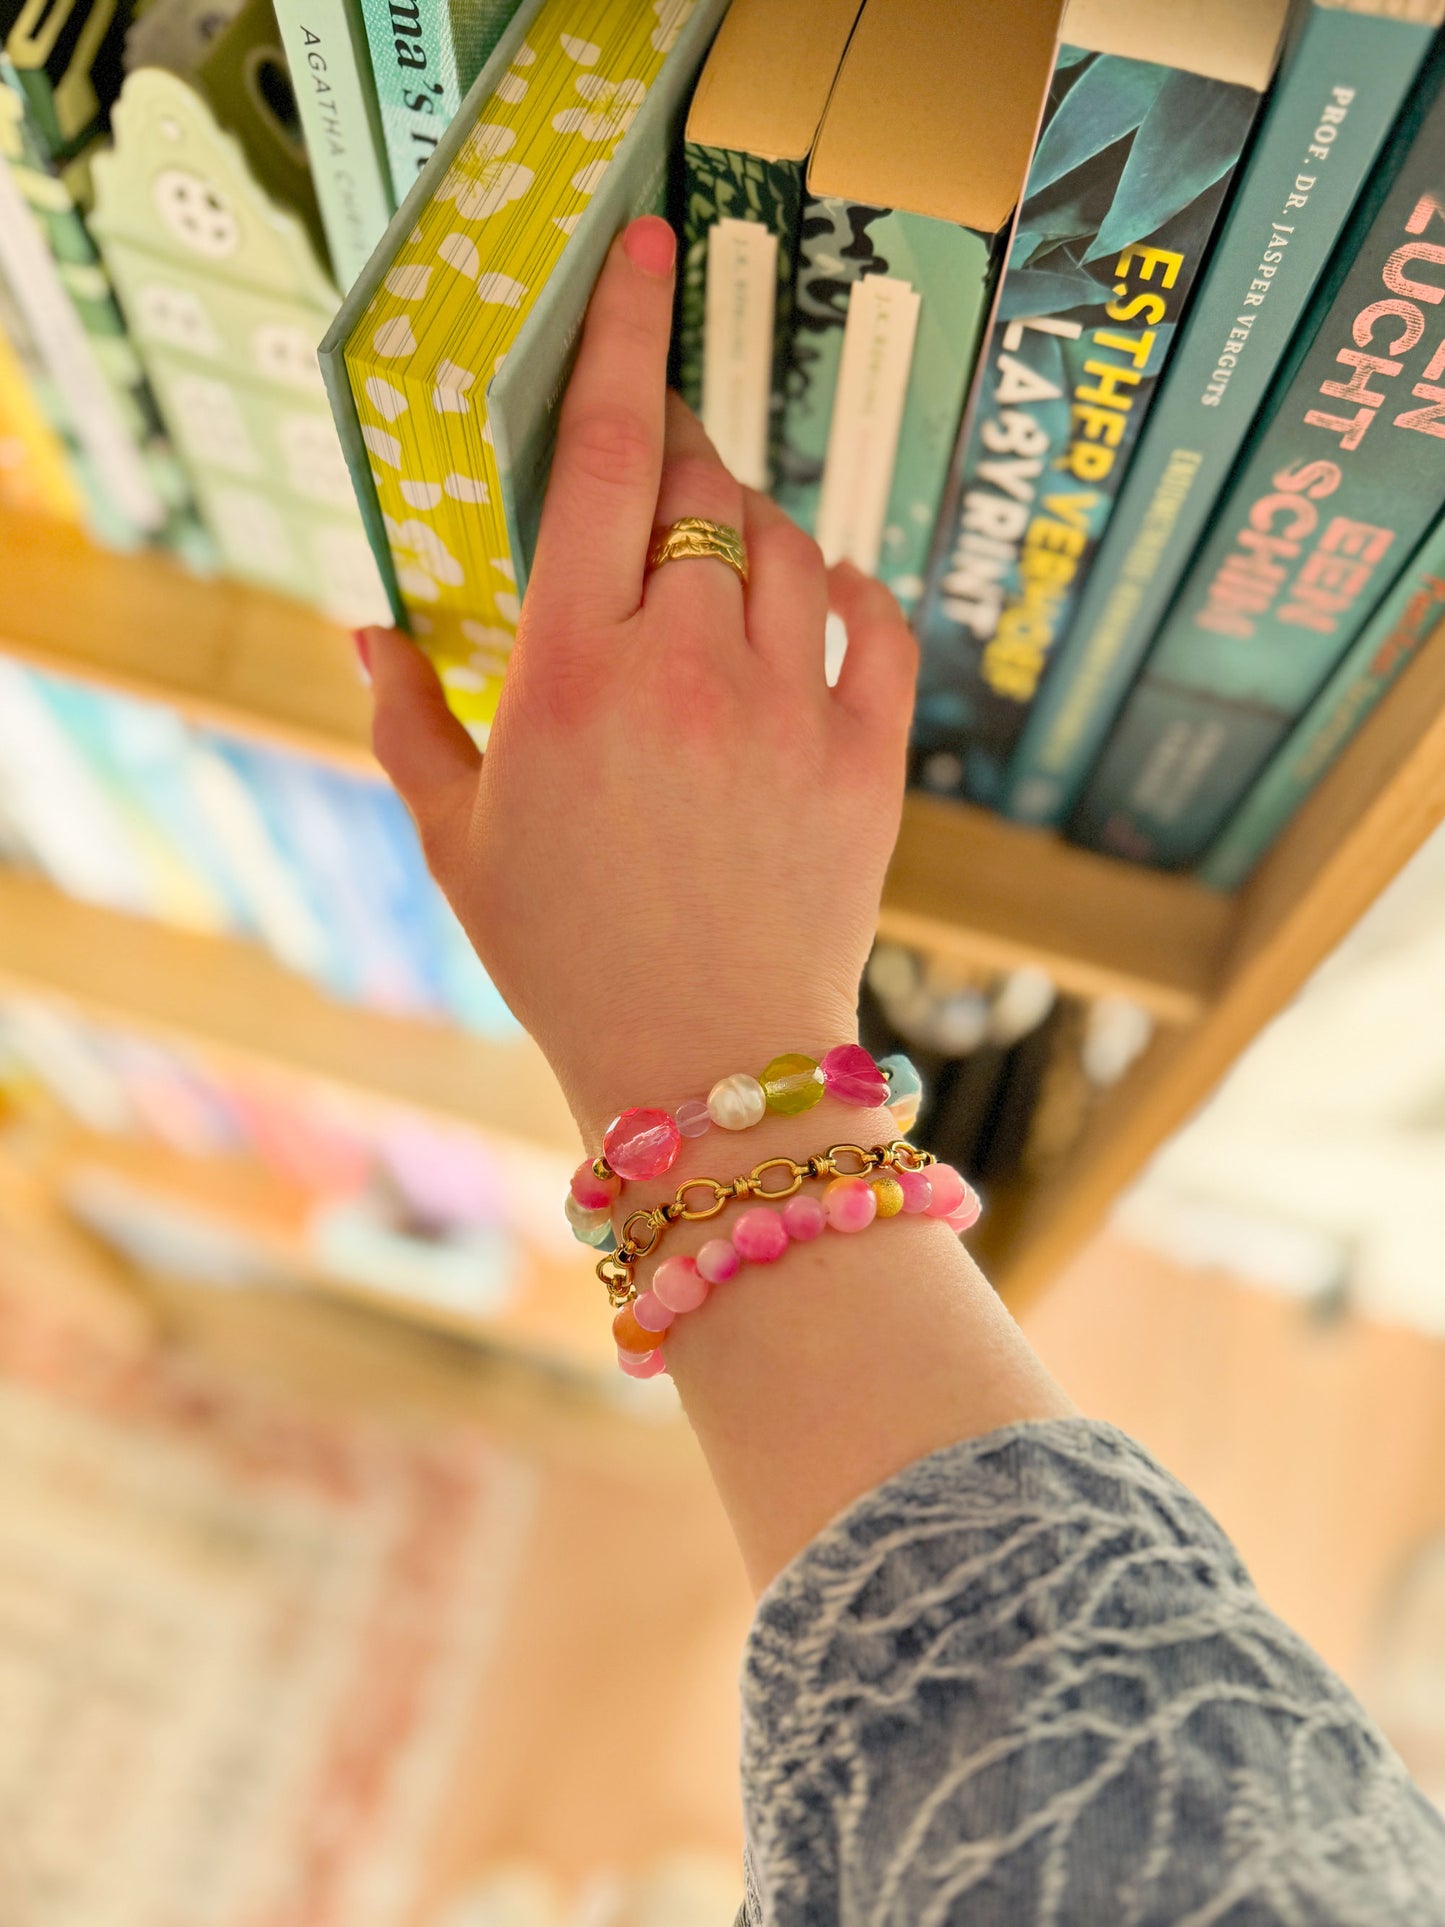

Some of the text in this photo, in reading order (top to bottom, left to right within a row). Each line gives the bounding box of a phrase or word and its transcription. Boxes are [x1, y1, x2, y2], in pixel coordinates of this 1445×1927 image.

[300, 25, 346, 157] AGATHA
[1201, 84, 1355, 407] PROF. DR. JASPER VERGUTS
[1051, 243, 1185, 481] ESTHER
[940, 317, 1083, 640] LABYRINT
[1194, 458, 1342, 640] SCHIM
[1275, 515, 1395, 634] EEN
